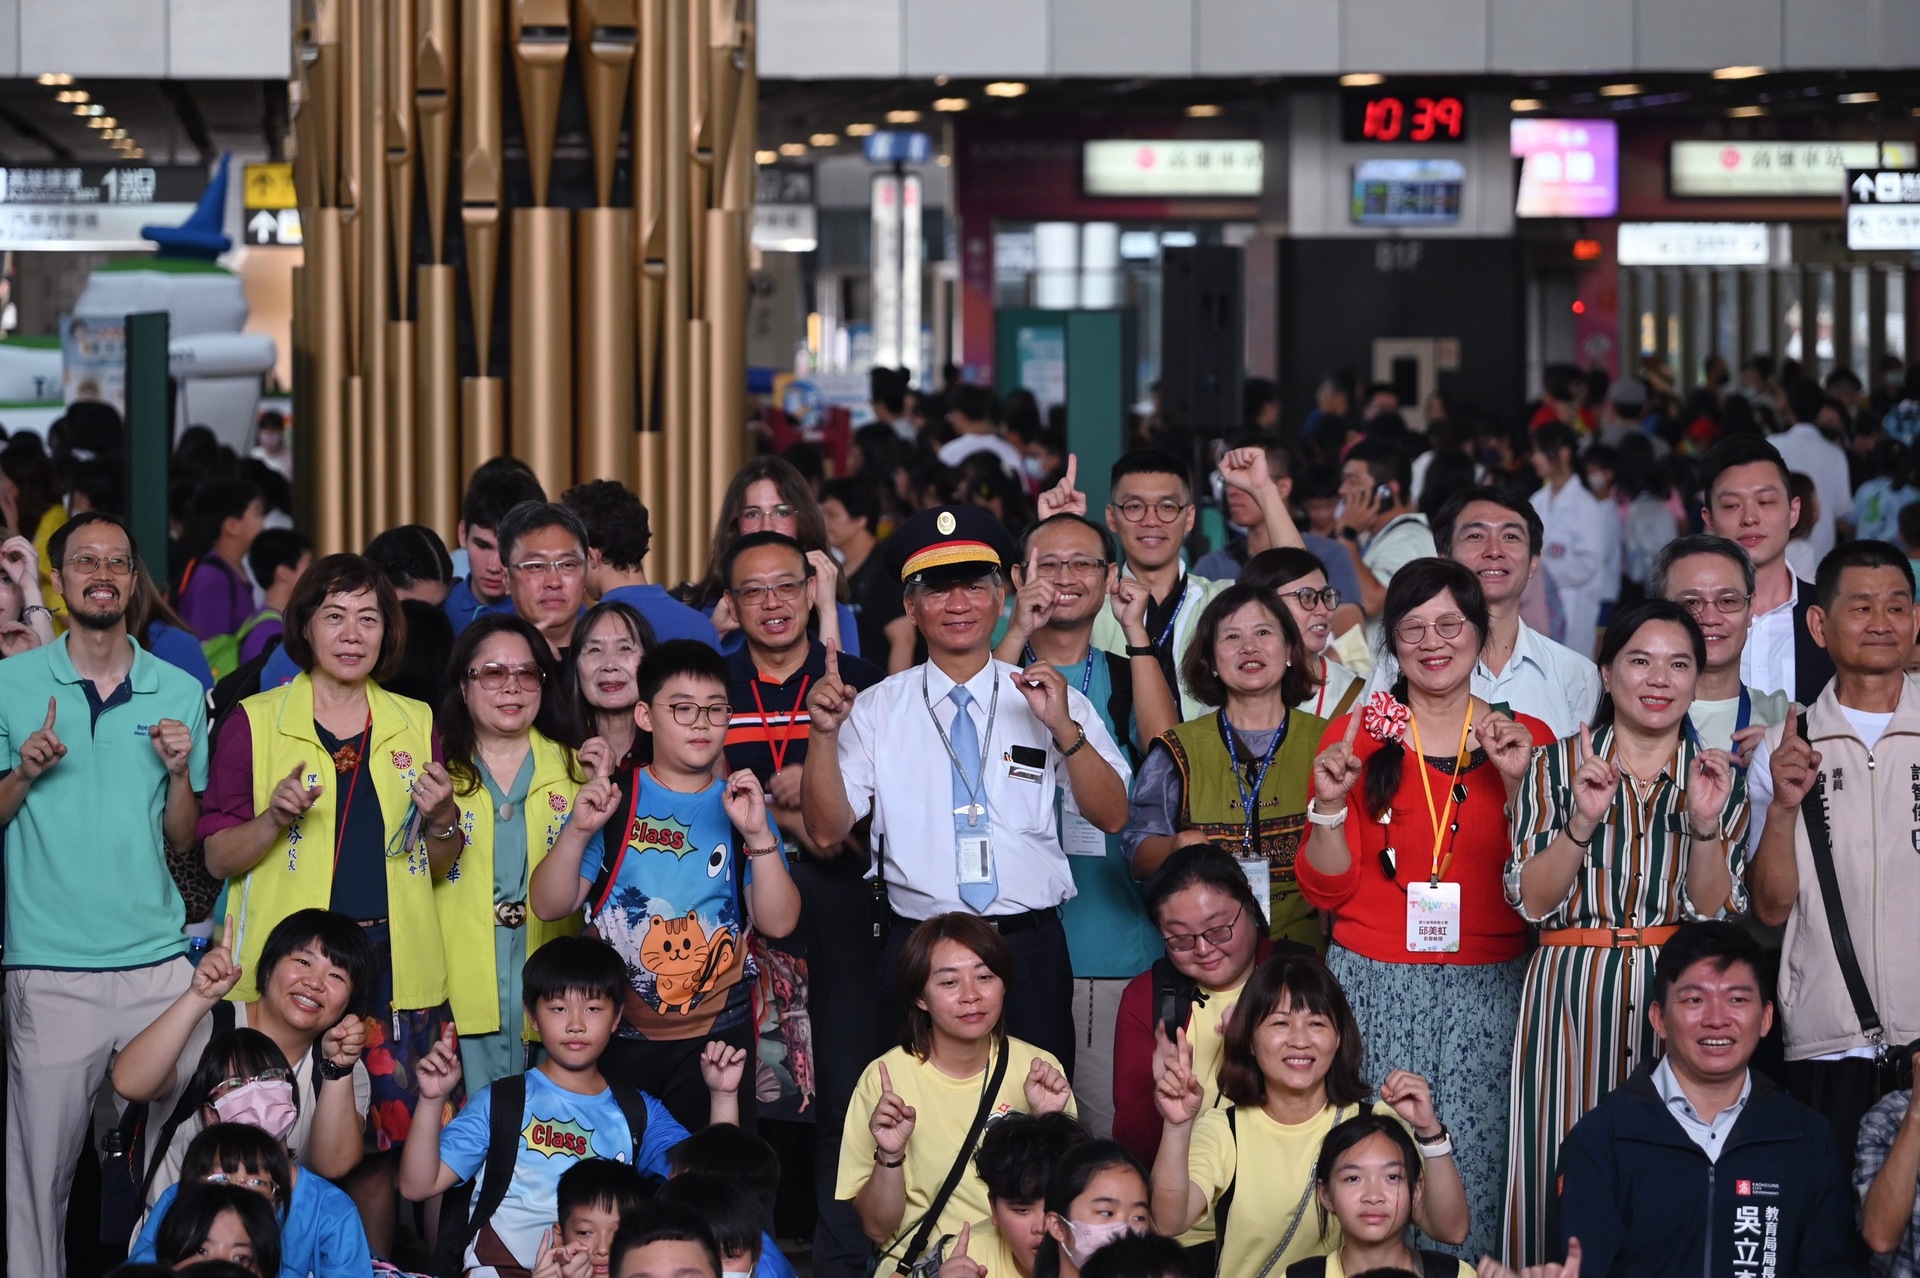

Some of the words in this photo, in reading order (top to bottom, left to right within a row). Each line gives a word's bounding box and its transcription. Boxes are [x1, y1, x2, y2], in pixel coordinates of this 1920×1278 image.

[101, 168, 117, 202] 1
[630, 820, 685, 849] Class
[1418, 926, 1448, 936] 邱美虹
[532, 1124, 587, 1155] Class
